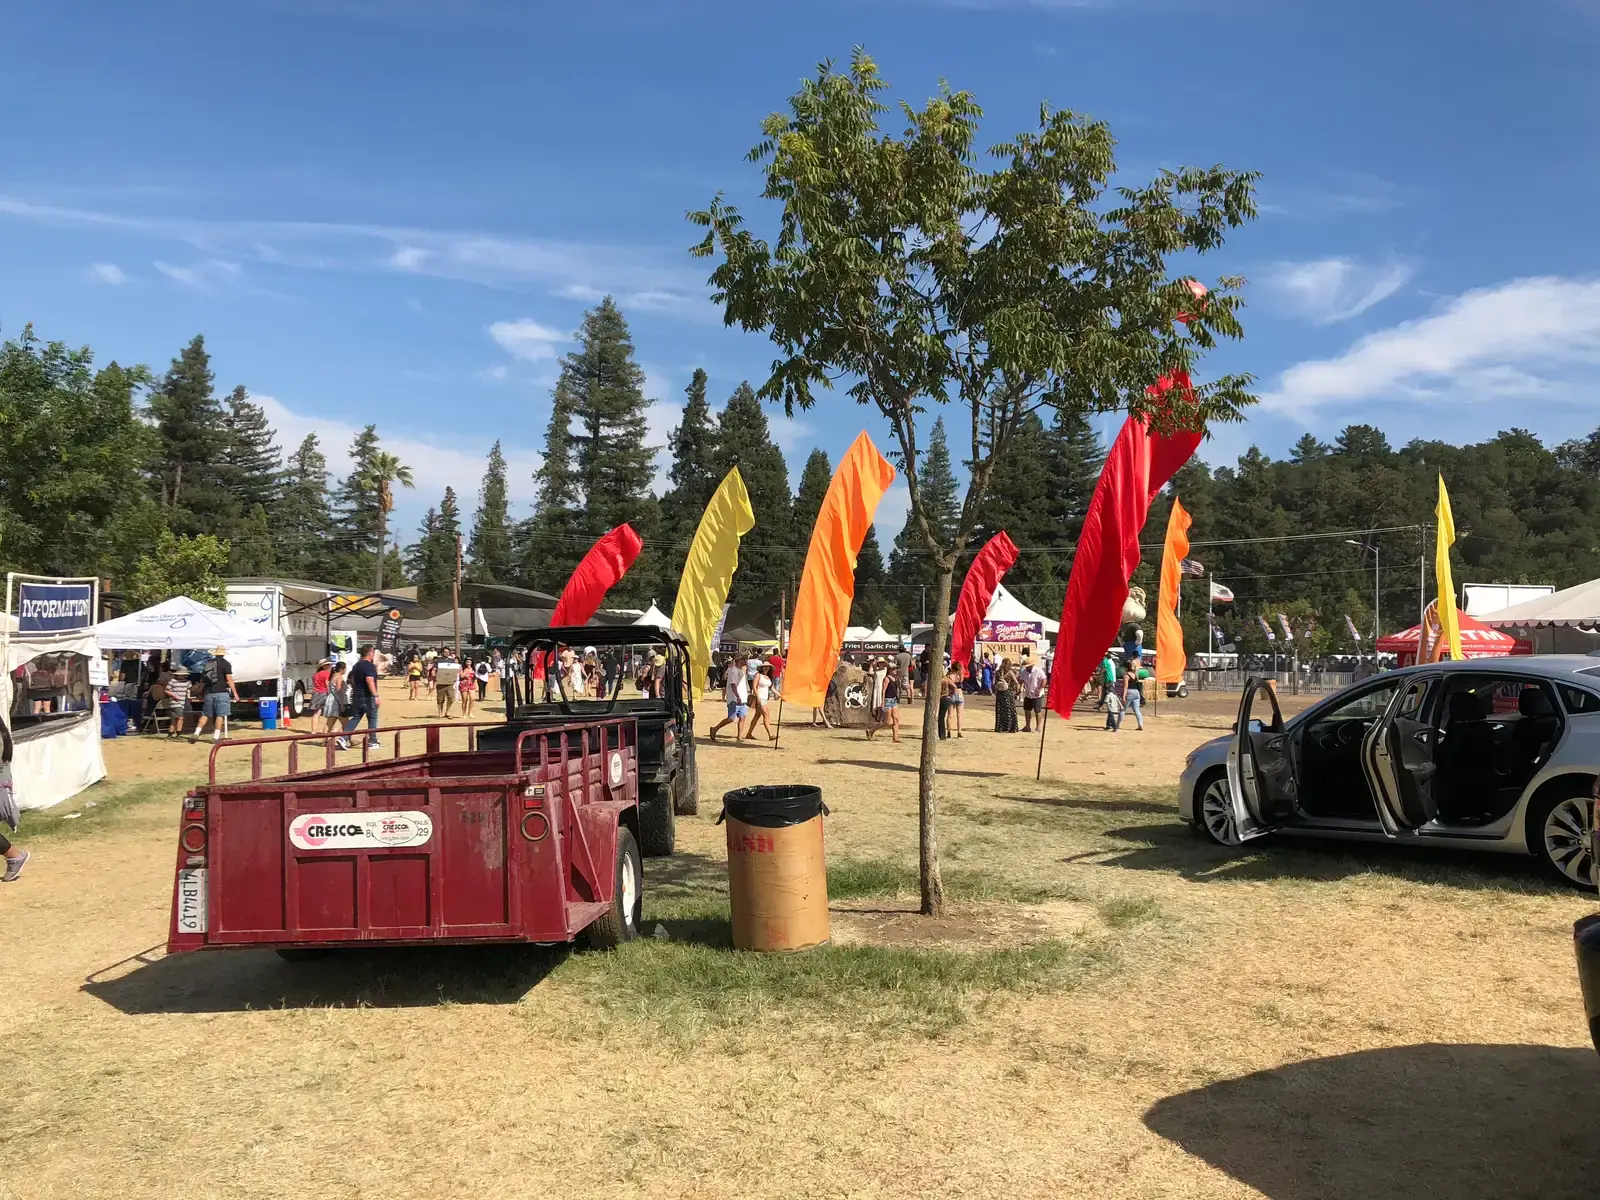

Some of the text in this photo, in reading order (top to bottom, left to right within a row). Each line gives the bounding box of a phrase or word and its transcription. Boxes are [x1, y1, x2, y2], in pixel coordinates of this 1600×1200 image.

[22, 599, 89, 618] INFORMATION
[307, 824, 364, 838] CRESCO
[382, 823, 409, 831] CRESCO
[183, 874, 197, 928] 4LB4419
